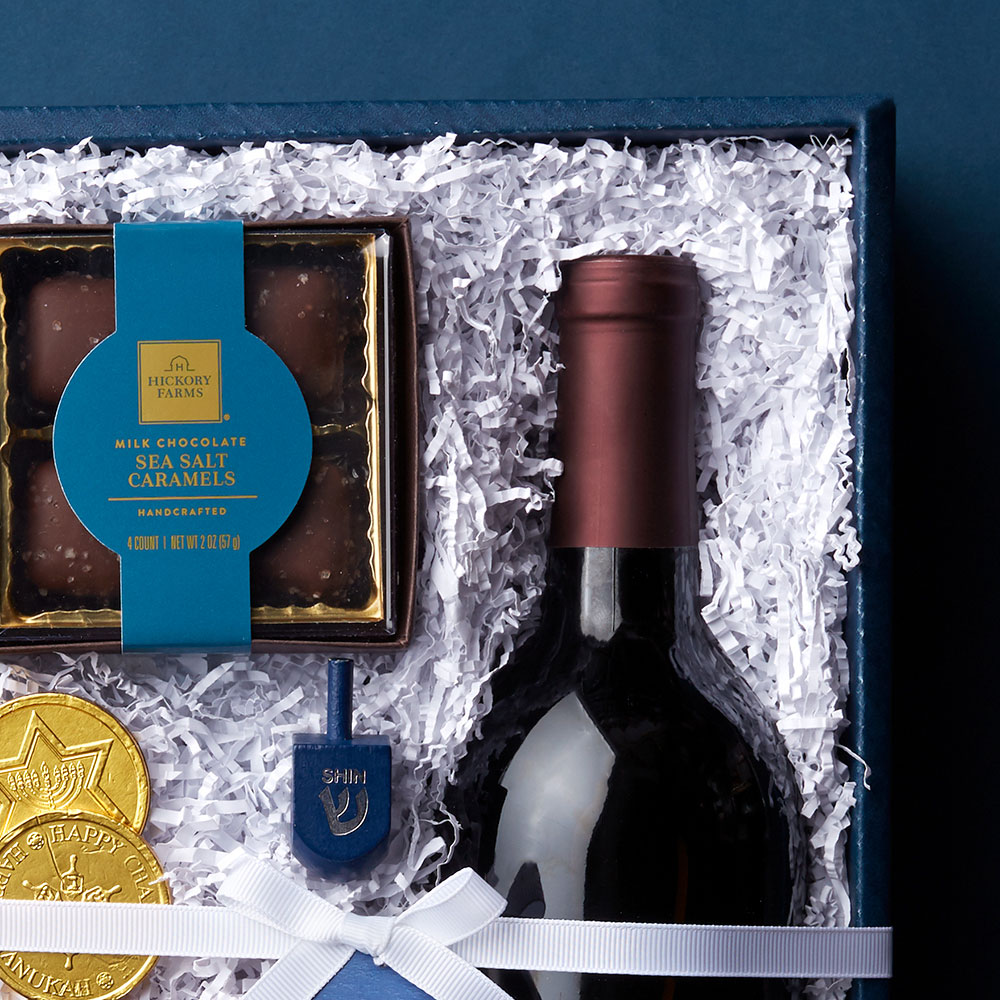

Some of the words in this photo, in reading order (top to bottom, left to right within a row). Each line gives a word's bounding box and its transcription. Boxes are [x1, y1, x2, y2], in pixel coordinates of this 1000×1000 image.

[148, 375, 212, 387] HICKORY
[157, 387, 204, 399] FARMS
[115, 438, 150, 449] MILK
[157, 436, 247, 448] CHOCOLATE
[135, 454, 174, 470] SEA
[180, 453, 229, 469] SALT
[128, 471, 236, 488] CARAMELS
[137, 507, 227, 517] HANDCRAFTED
[127, 535, 133, 550] 4
[134, 535, 160, 550] COUNT
[170, 535, 185, 550] NET
[186, 534, 198, 550] WT
[200, 534, 206, 550] 2
[207, 534, 217, 549] OZ
[218, 534, 231, 551] (57
[321, 767, 367, 786] SHIN
[48, 824, 127, 855] HAPPY
[0, 951, 92, 998] ANUKAH
